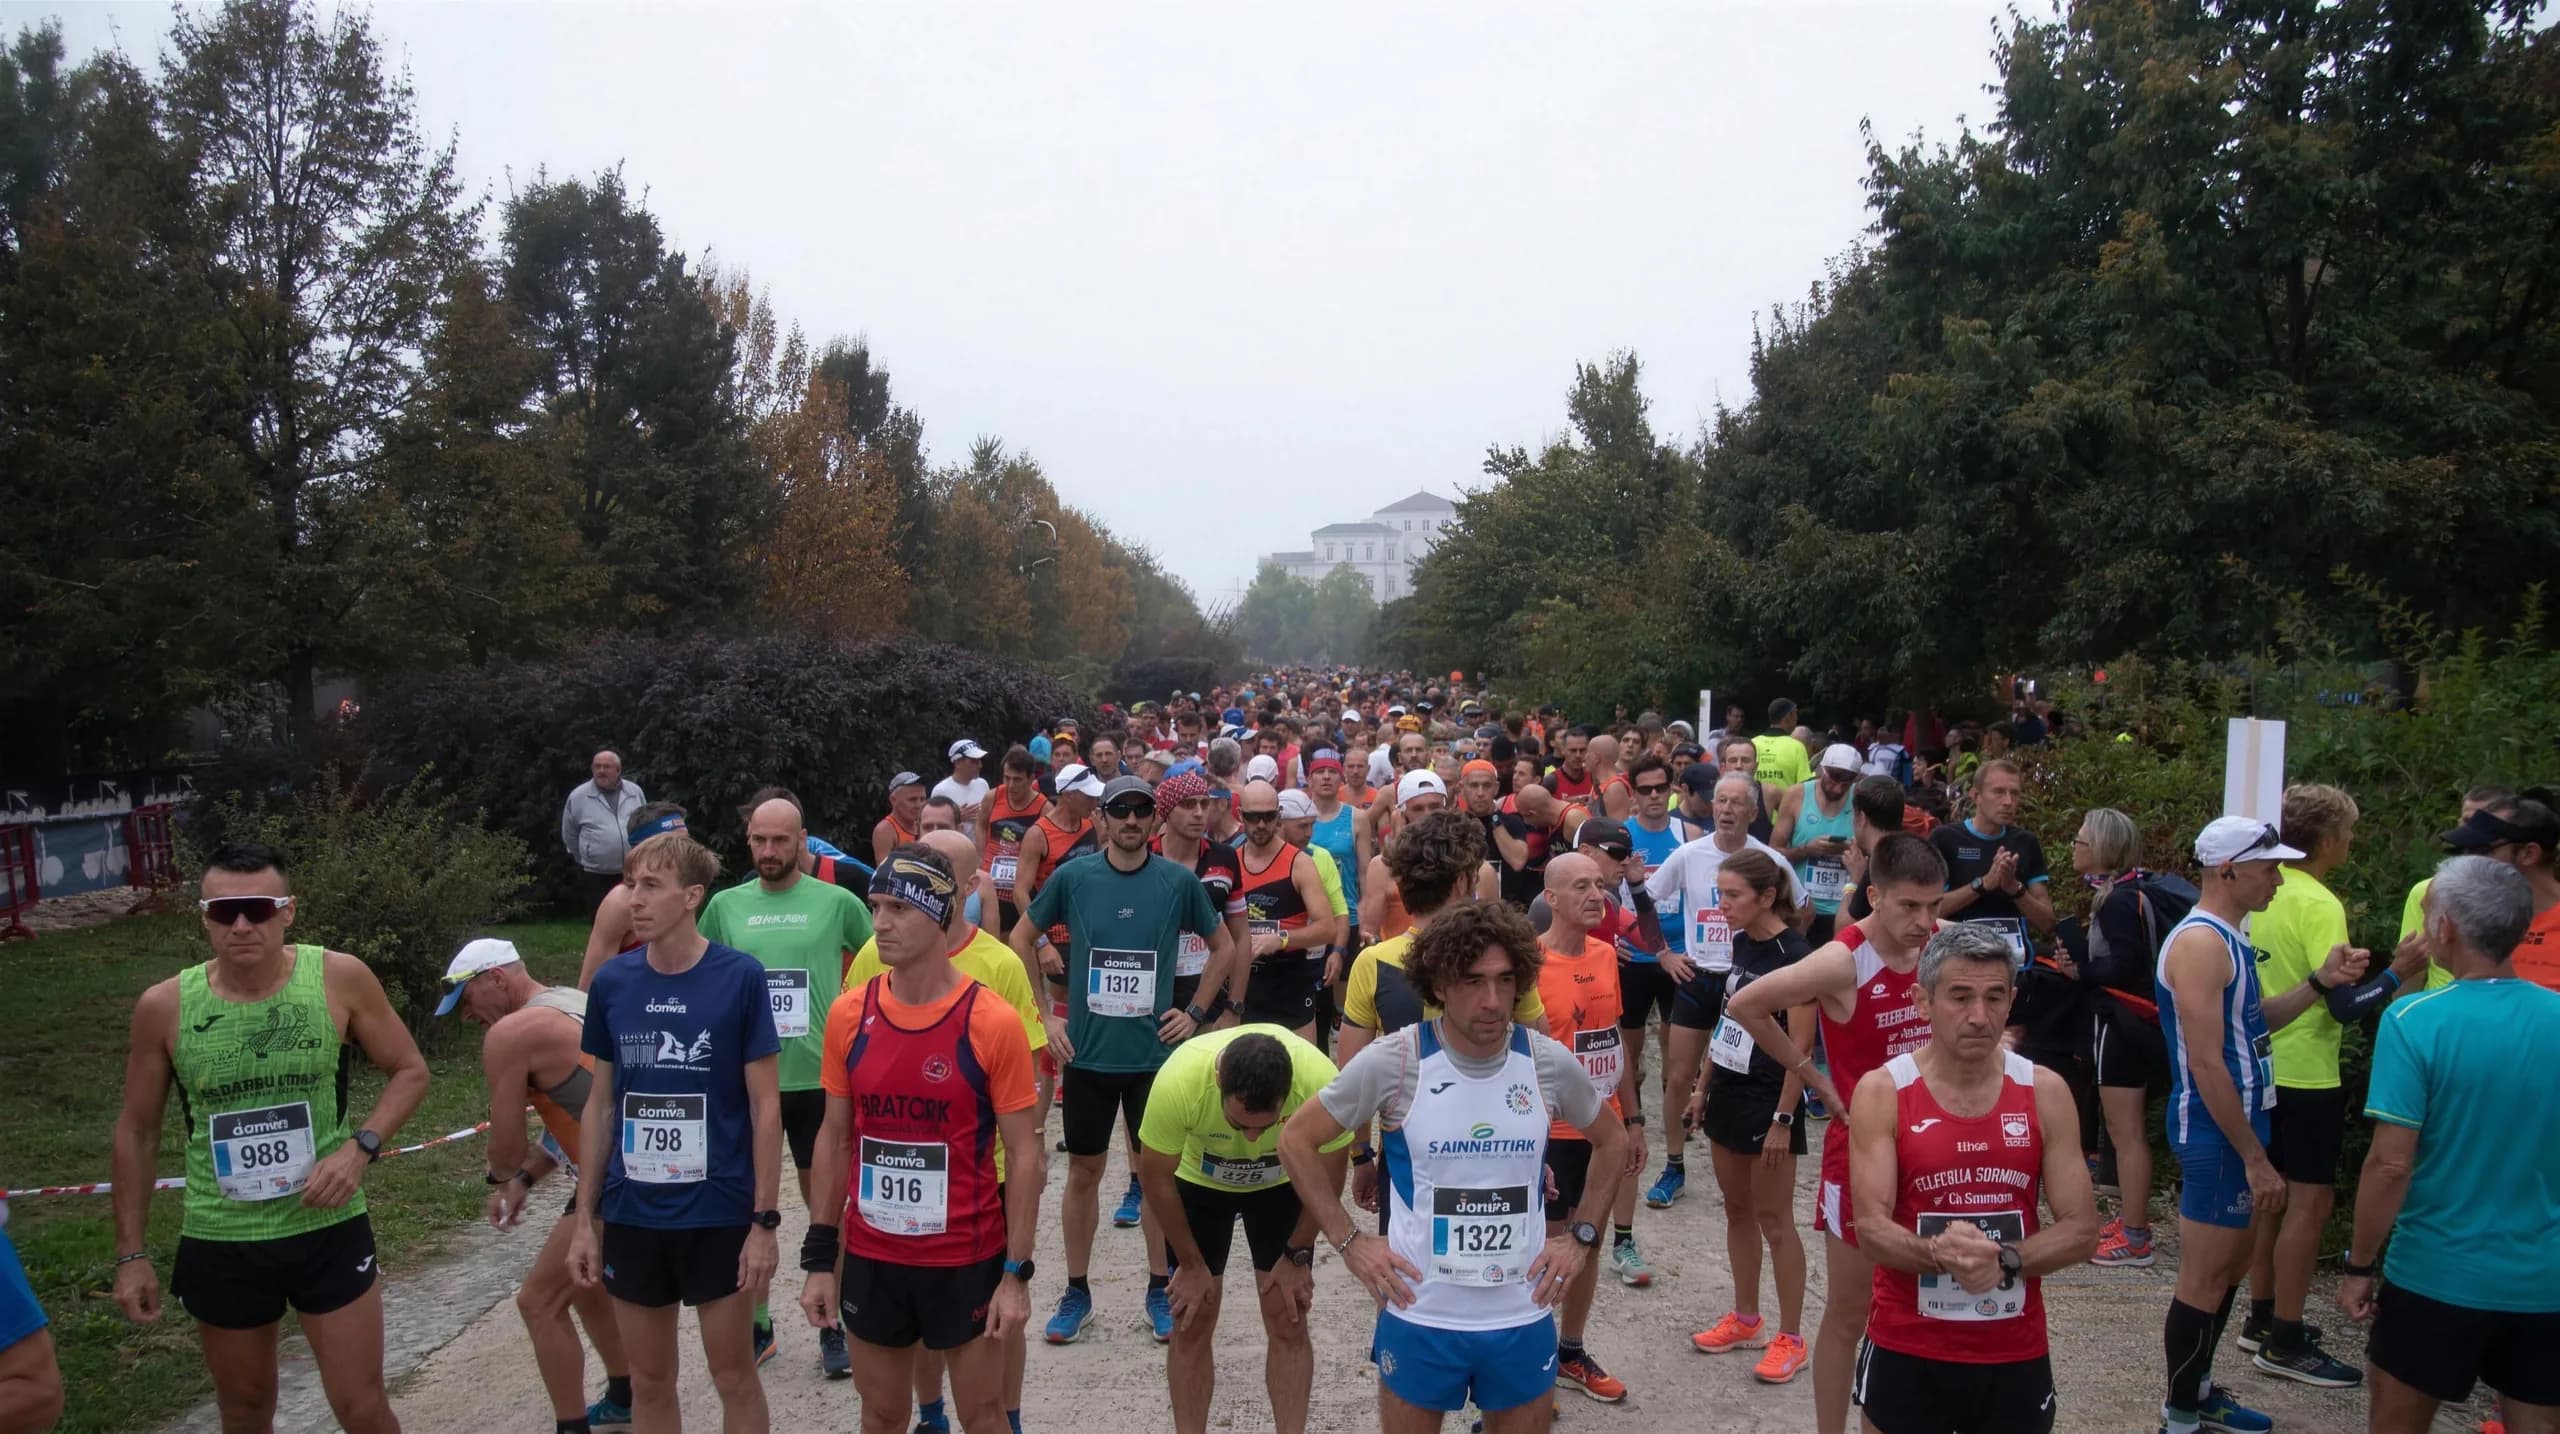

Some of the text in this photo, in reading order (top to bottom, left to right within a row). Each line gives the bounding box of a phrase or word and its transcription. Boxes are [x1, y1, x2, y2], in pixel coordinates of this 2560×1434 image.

[1105, 974, 1140, 995] 1312
[1588, 1054, 1616, 1076] 1014
[642, 1127, 682, 1151] 798
[240, 1140, 290, 1169] 988
[881, 1175, 922, 1203] 916
[1453, 1223, 1512, 1252] 1322
